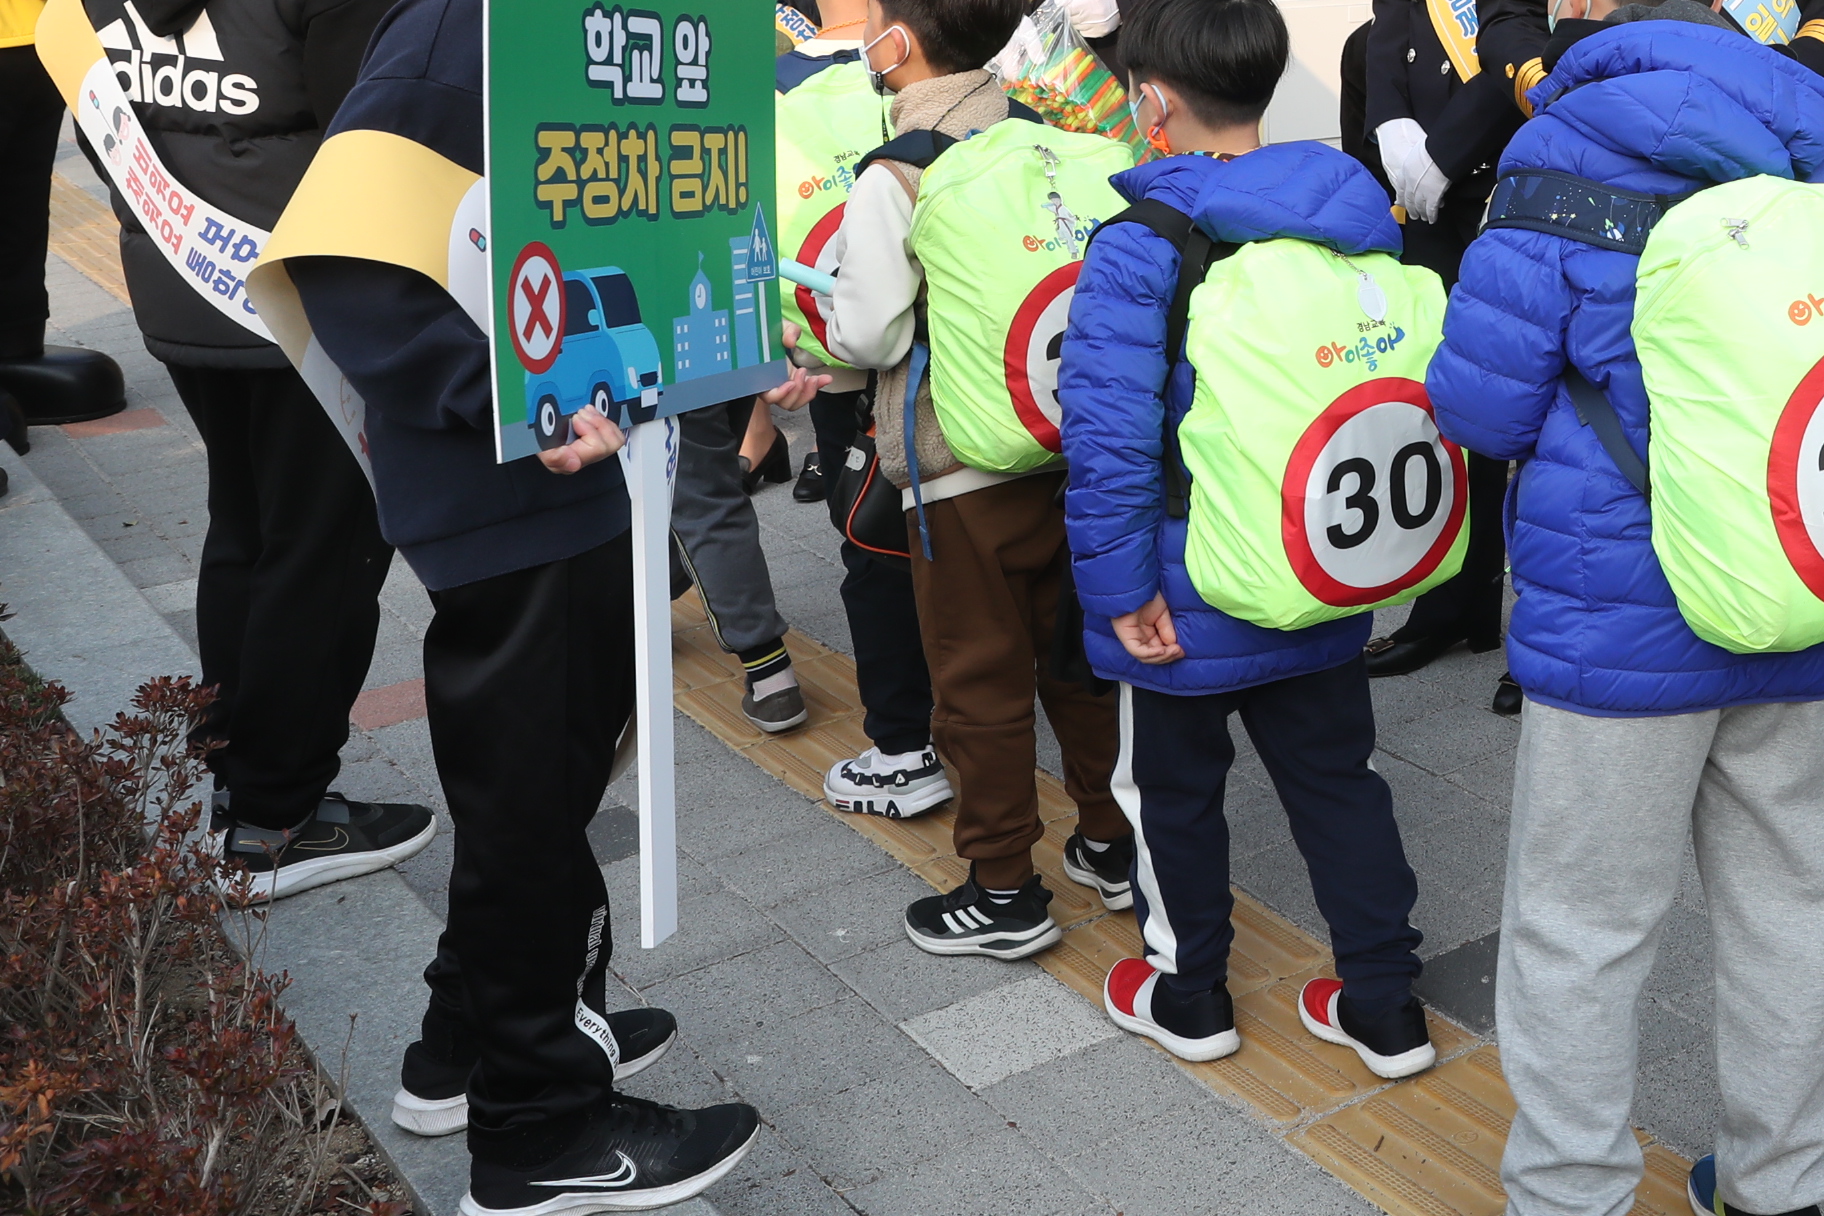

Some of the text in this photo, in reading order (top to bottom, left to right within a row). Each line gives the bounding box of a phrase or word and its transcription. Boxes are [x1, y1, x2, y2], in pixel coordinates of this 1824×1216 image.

[111, 48, 260, 115] didas
[585, 7, 710, 103] 학교 앞
[536, 129, 748, 222] 주정차 금지!
[1315, 324, 1405, 372] 아이좋아
[1326, 441, 1442, 550] 30
[576, 1007, 616, 1058] Everything
